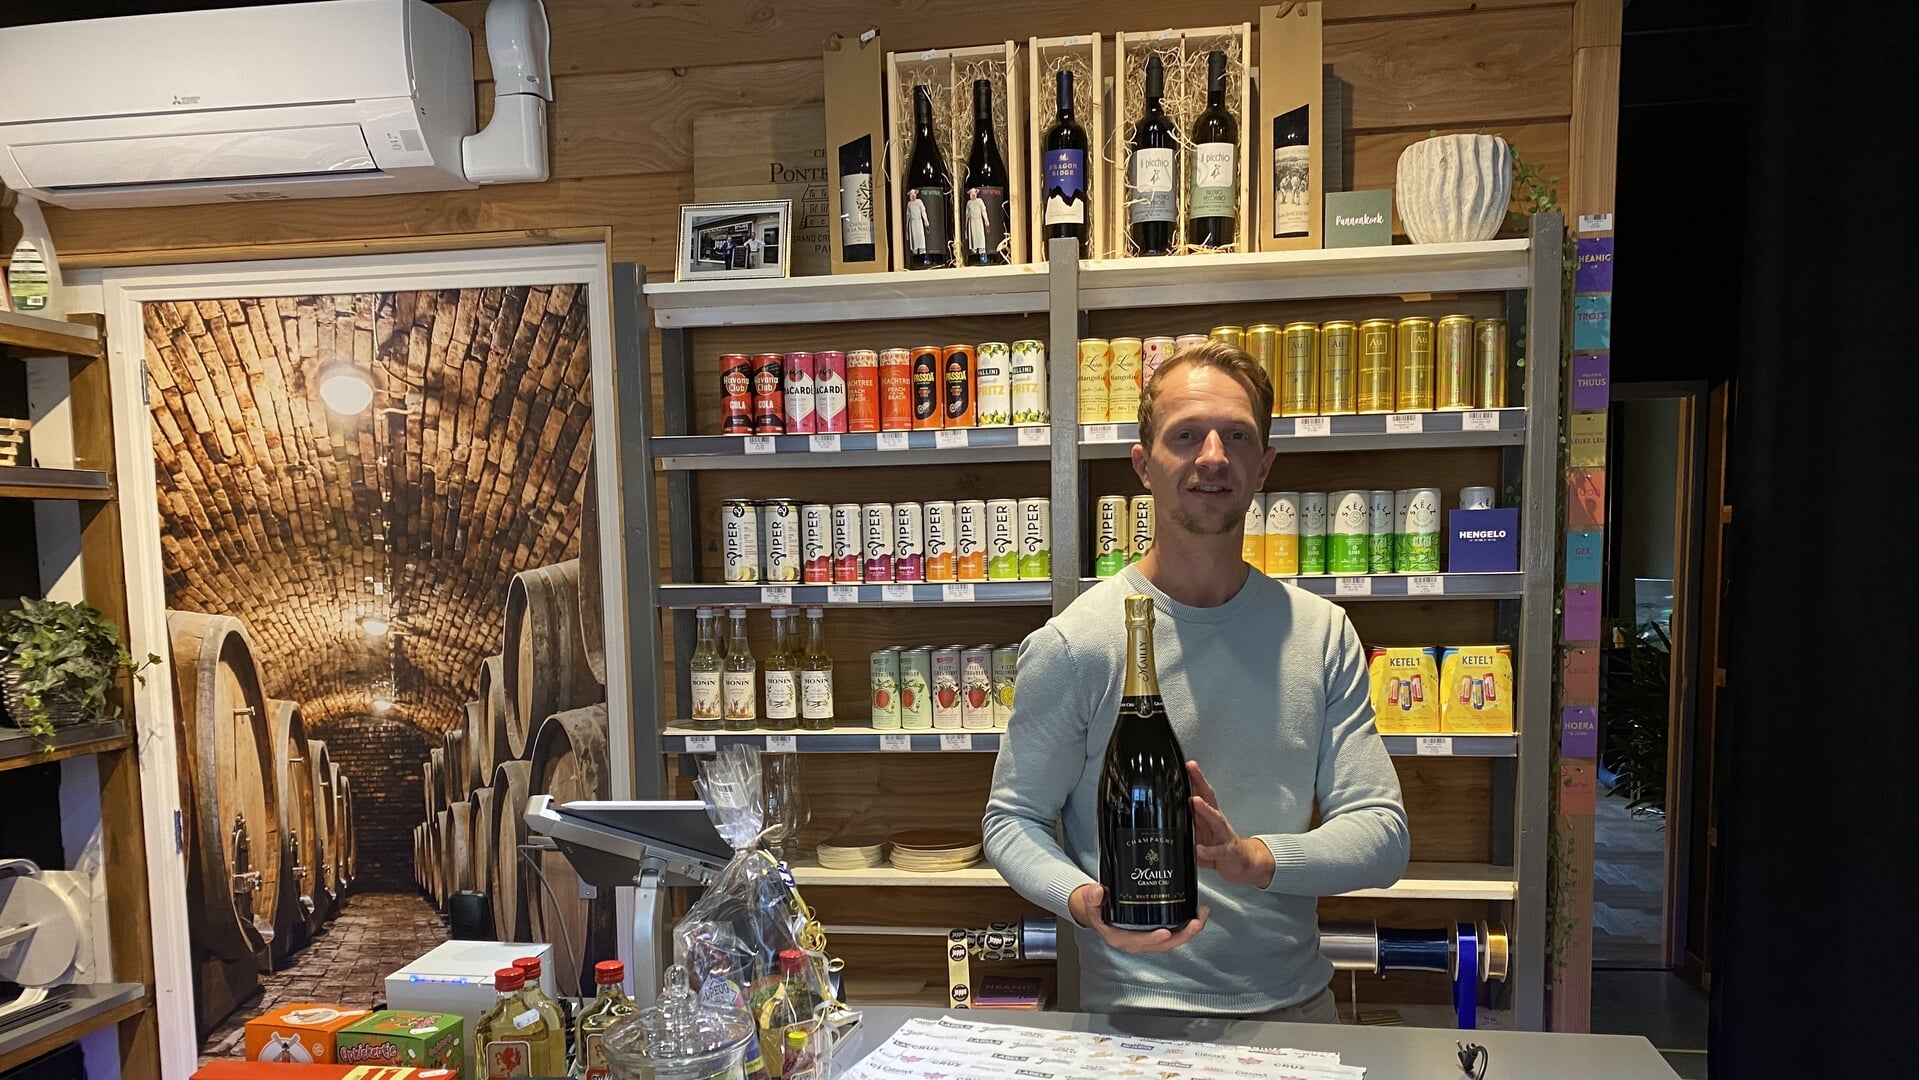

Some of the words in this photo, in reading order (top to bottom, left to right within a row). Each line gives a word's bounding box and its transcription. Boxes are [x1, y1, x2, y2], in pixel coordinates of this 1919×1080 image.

[1145, 159, 1169, 168] picchio
[1206, 153, 1231, 164] picchio
[1050, 162, 1077, 170] DRAGON
[1336, 212, 1384, 227] Pannenkoek
[1578, 253, 1611, 263] HEANIG
[1369, 338, 1383, 347] Au
[1415, 335, 1428, 345] Au
[724, 376, 749, 385] Havana
[1577, 378, 1606, 388] THUUS
[729, 383, 745, 392] Club
[757, 382, 773, 391] Club
[730, 400, 746, 410] COLA
[758, 399, 774, 409] COLA
[928, 507, 946, 554] VIPER
[960, 506, 977, 554] VIPER
[994, 505, 1012, 553] VIPER
[1024, 504, 1043, 552] VIPER
[1100, 502, 1117, 550] VIPER
[1134, 502, 1152, 550] VIPER
[806, 511, 823, 558] VIPER
[835, 509, 851, 556] VIPER
[868, 509, 885, 556] VIPER
[897, 508, 914, 555] VIPER
[1459, 530, 1507, 539] HENGELO
[727, 521, 742, 566] VIPER
[771, 521, 787, 566] VIPER
[1564, 721, 1594, 730] HOERA
[1126, 837, 1175, 847] CHAMPAGNE
